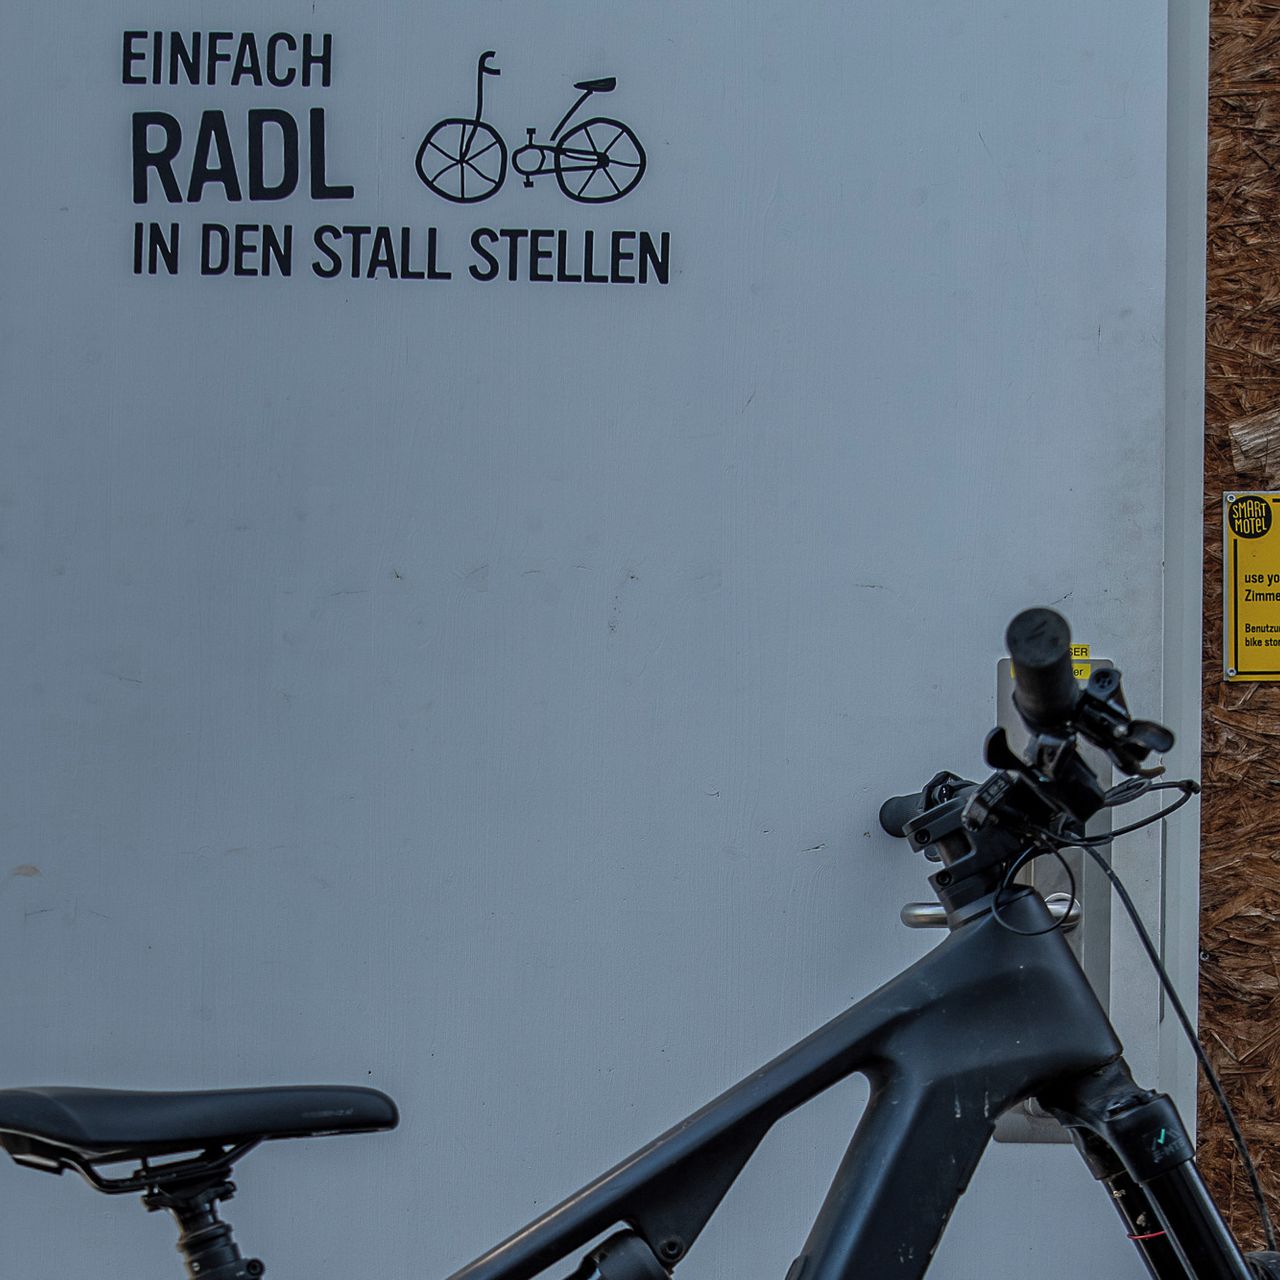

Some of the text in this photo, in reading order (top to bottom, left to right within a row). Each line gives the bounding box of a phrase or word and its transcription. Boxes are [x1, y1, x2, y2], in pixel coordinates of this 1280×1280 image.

[122, 30, 333, 88] EINFACH
[131, 107, 355, 204] RADL
[133, 221, 670, 285] IN DEN STALL STELLEN
[1232, 499, 1267, 519] SMART
[1244, 573, 1264, 583] use
[1245, 636, 1263, 647] bike
